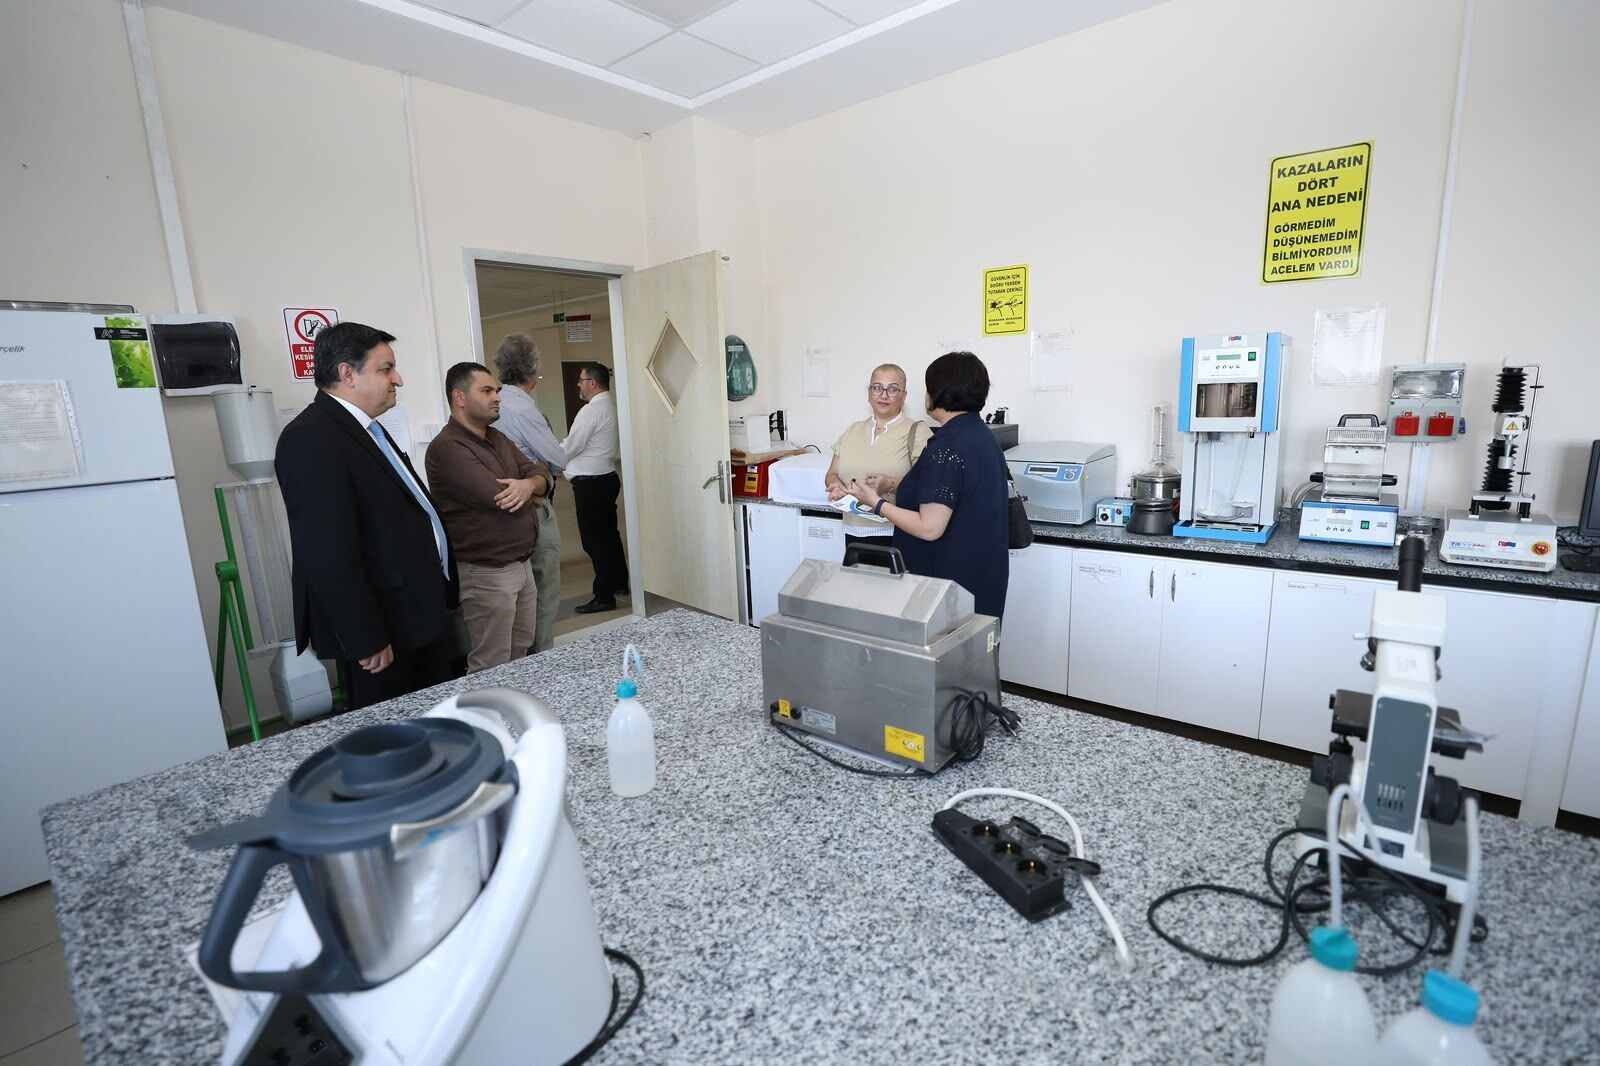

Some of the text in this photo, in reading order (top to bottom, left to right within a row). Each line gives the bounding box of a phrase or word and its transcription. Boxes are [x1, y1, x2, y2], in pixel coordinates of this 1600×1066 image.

[1277, 155, 1364, 178] KAZALARIN
[1297, 176, 1338, 192] DÖRT
[1271, 188, 1363, 213] ANA NEDENİ
[1274, 217, 1336, 233] GÖRMEDİM
[1273, 229, 1358, 248] DÜŞÜNEMEDİM
[1272, 245, 1352, 261] BİLMİYORDUM
[1271, 259, 1354, 275] ACELEM VARDI
[0, 345, 25, 354] rçelik
